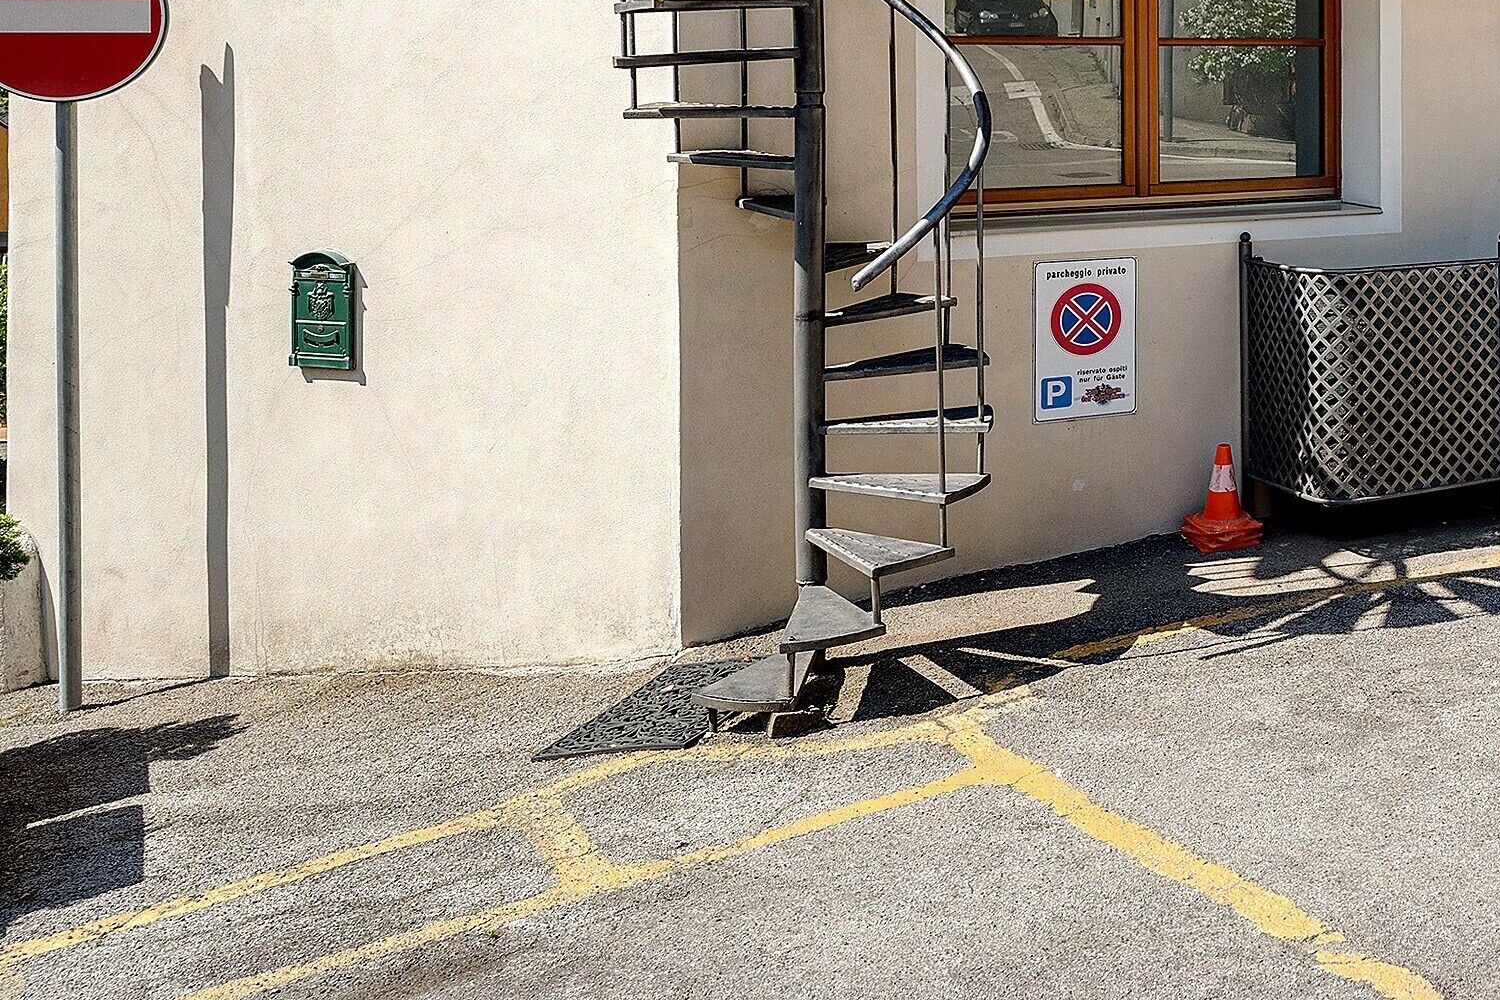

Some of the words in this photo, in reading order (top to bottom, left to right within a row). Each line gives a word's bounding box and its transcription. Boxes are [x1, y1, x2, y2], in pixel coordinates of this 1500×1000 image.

[1046, 267, 1092, 280] parcheggio
[1097, 266, 1127, 277] privato
[1076, 367, 1107, 376] riservato
[1108, 365, 1128, 373] ospiti
